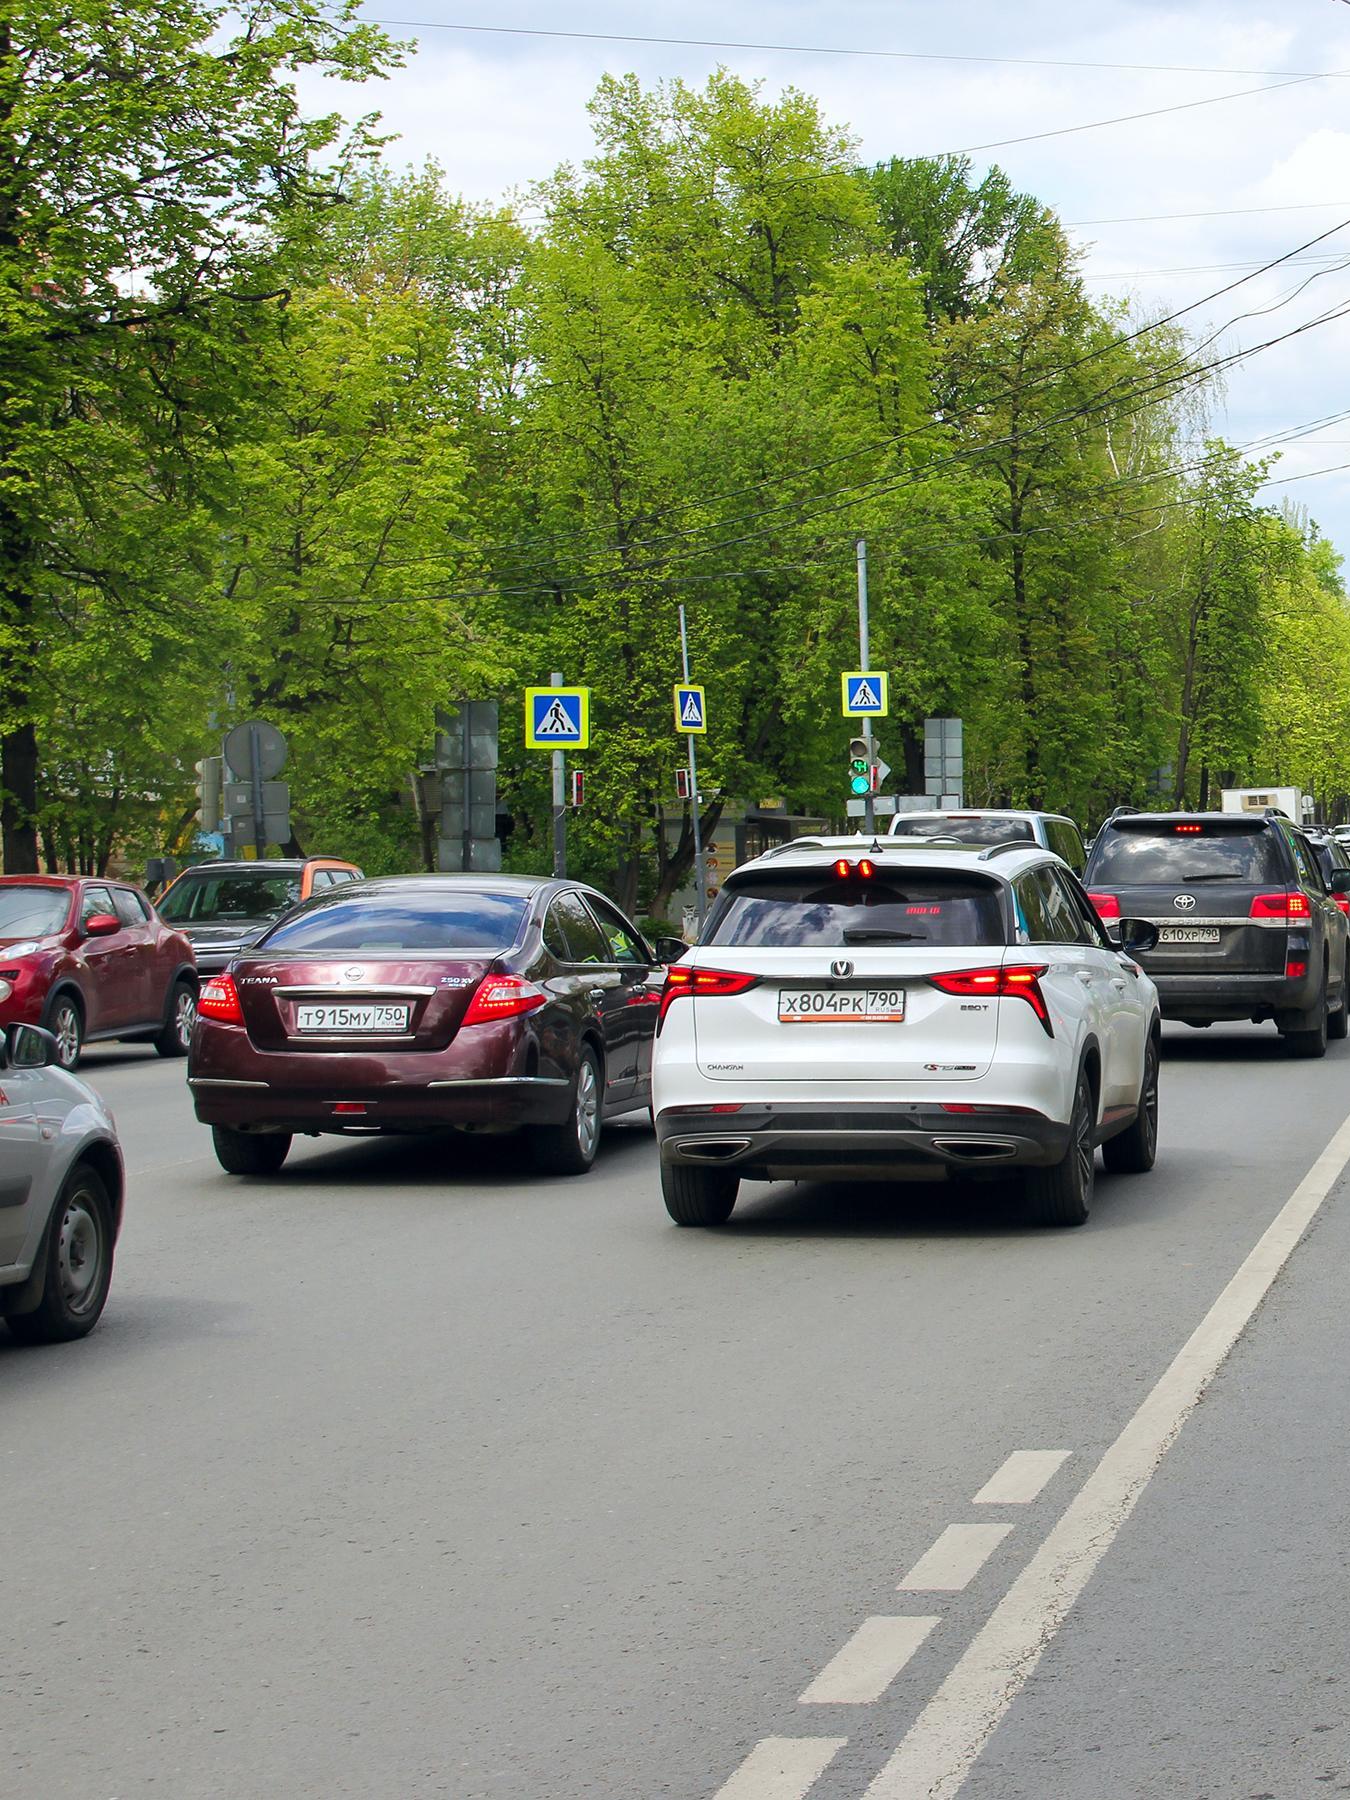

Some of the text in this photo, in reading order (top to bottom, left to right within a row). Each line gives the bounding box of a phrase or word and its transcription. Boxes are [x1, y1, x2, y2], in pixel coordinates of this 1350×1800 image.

[1158, 928, 1218, 941] 610ХР 790
[240, 977, 278, 985] TEANA
[461, 976, 475, 984] XV
[786, 991, 898, 1013] Х804РК 790
[304, 1007, 402, 1026] Т915МУ 750
